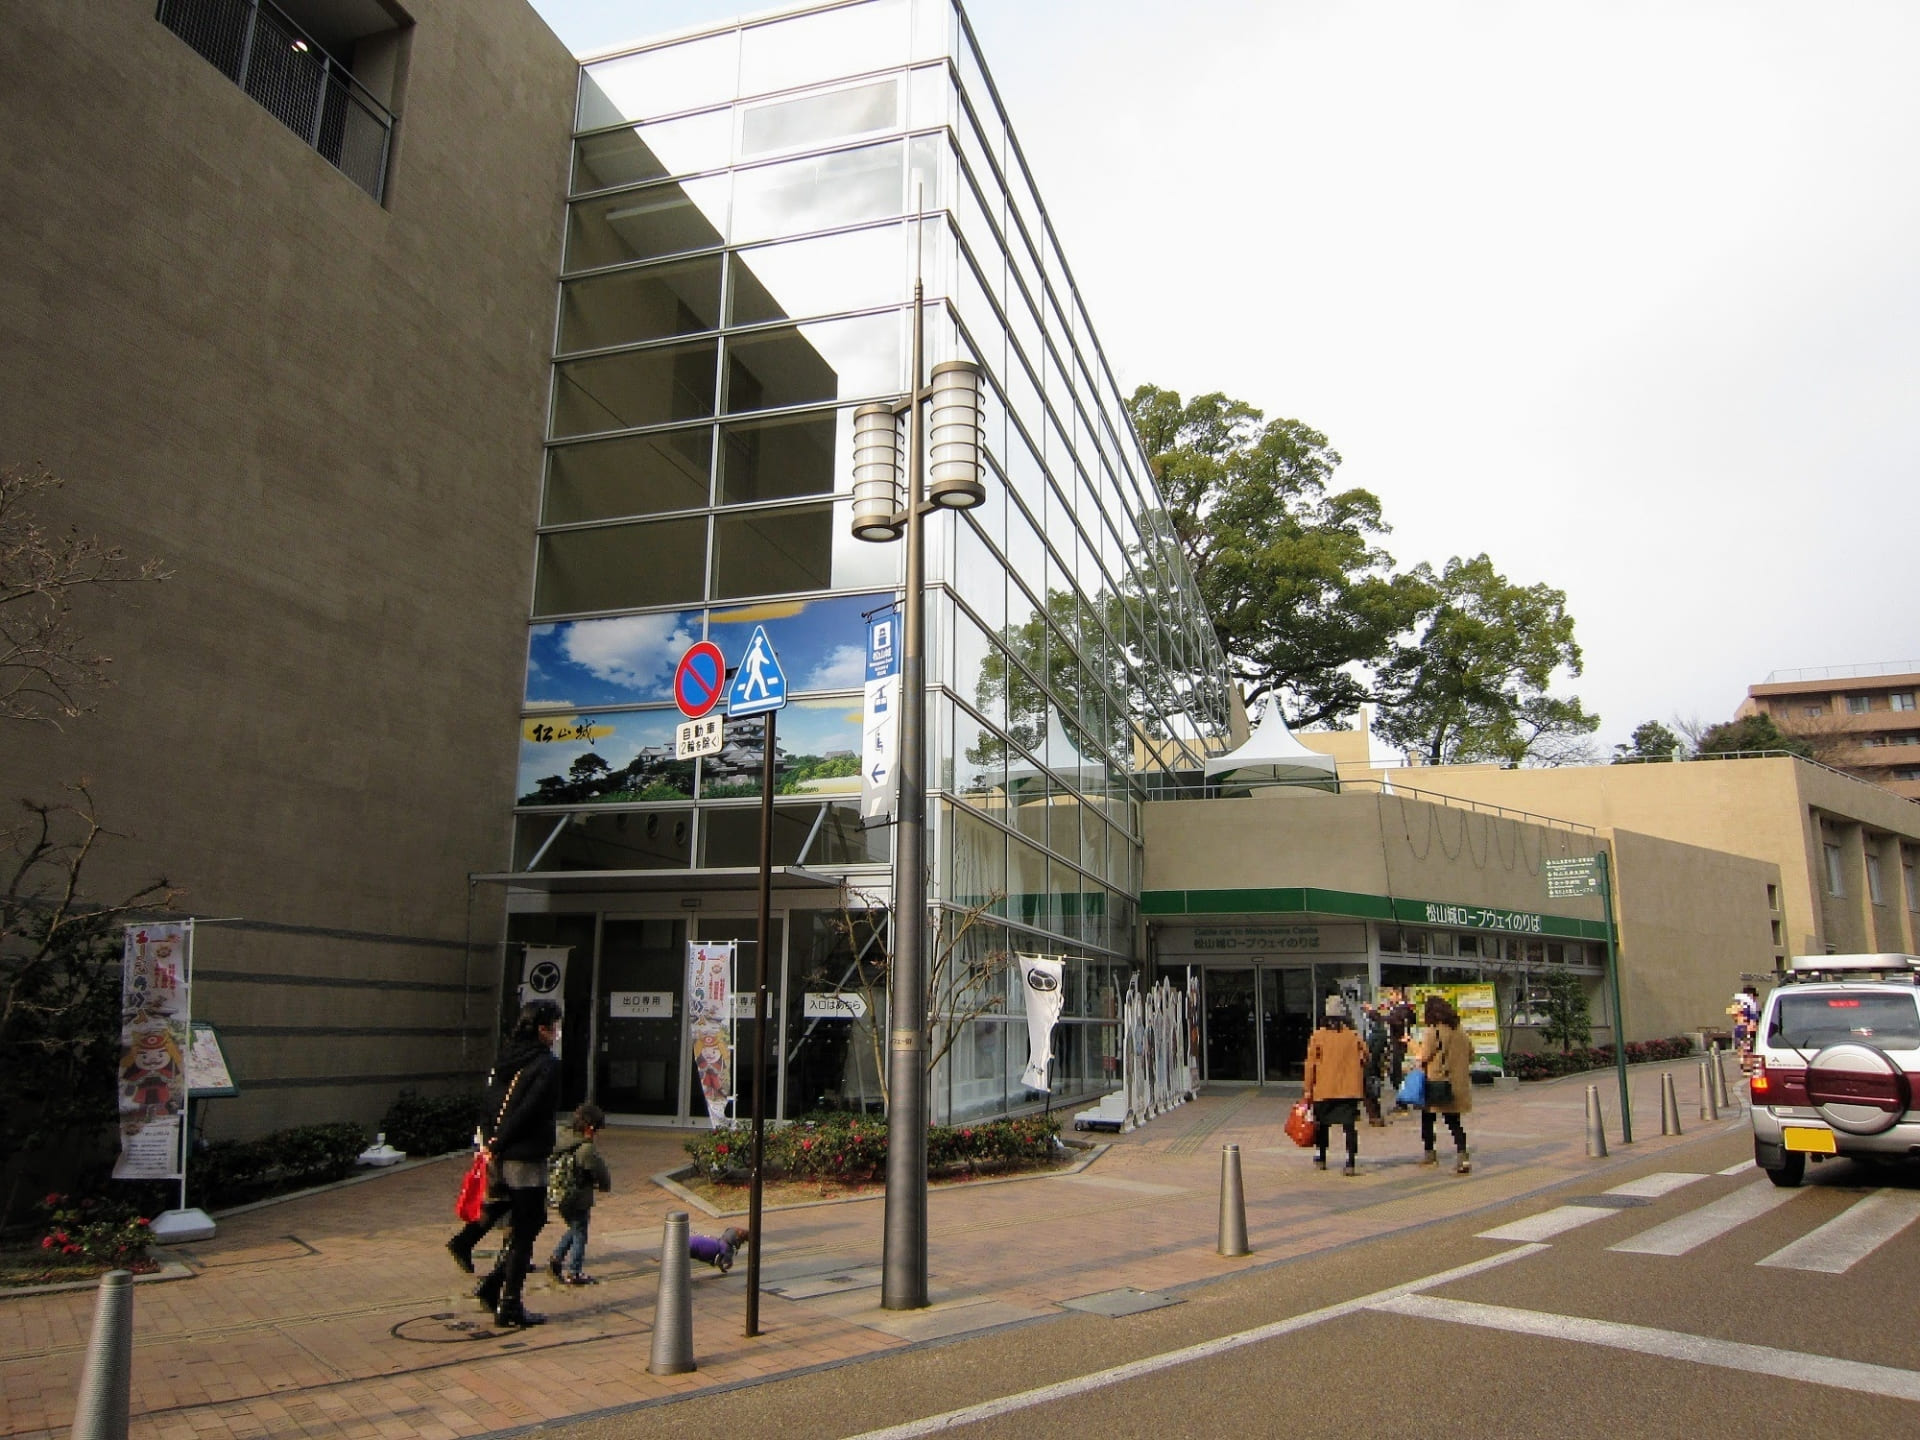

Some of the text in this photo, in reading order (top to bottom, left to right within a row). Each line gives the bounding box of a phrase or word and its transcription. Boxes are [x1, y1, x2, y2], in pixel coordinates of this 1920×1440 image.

[533, 719, 595, 745] 松山城
[683, 722, 715, 741] 自動車
[1426, 904, 1540, 932] 松山城ロープウェイのりば
[1194, 937, 1320, 949] 松山城ロープウェイのりば
[623, 996, 661, 1005] 出口専用
[810, 1000, 861, 1010] 入口はあちら
